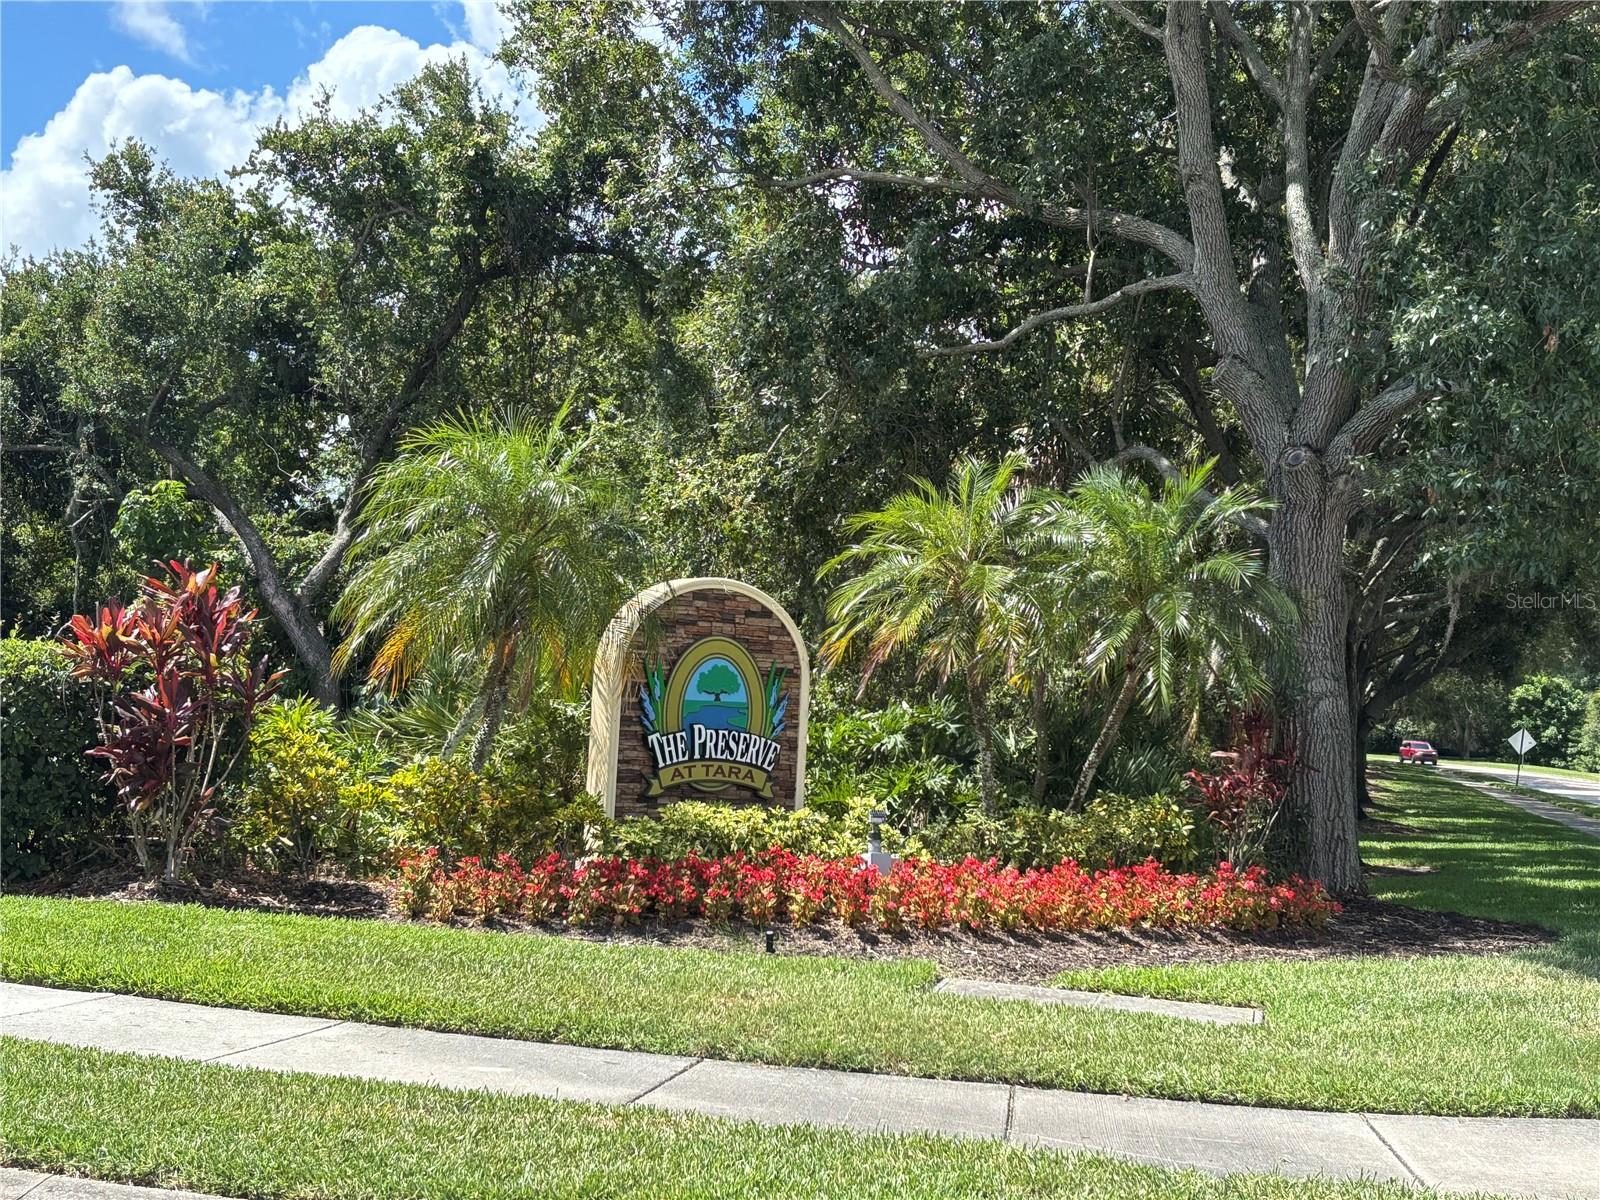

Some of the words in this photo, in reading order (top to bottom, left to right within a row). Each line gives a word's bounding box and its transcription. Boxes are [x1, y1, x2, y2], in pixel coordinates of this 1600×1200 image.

[648, 731, 689, 768] THE
[692, 724, 781, 772] PRESERVE
[670, 765, 697, 781] AT
[701, 764, 755, 783] TARA
